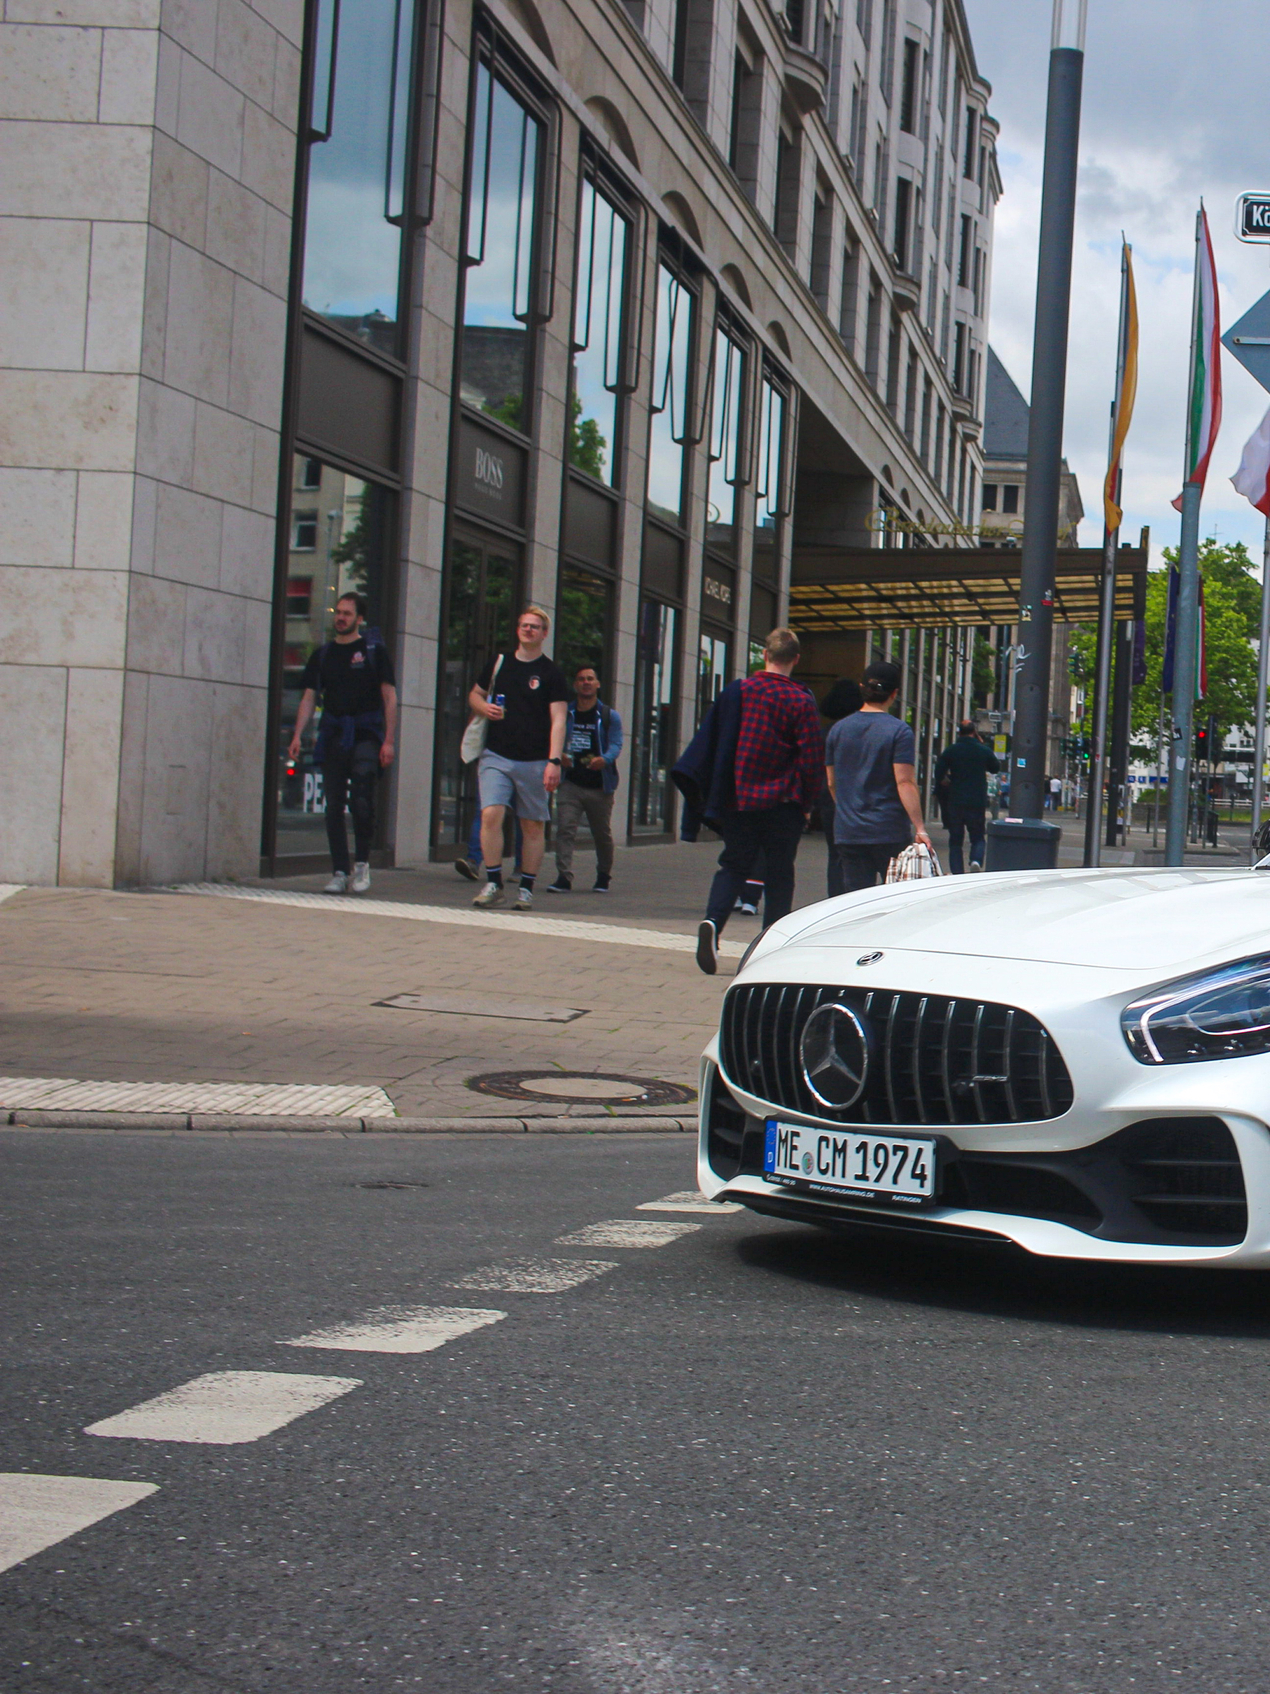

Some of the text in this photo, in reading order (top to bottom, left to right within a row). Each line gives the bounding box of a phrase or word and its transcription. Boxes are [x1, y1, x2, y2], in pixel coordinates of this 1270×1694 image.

[475, 447, 503, 489] BOSS
[767, 1128, 928, 1188] D ME CM 1974
